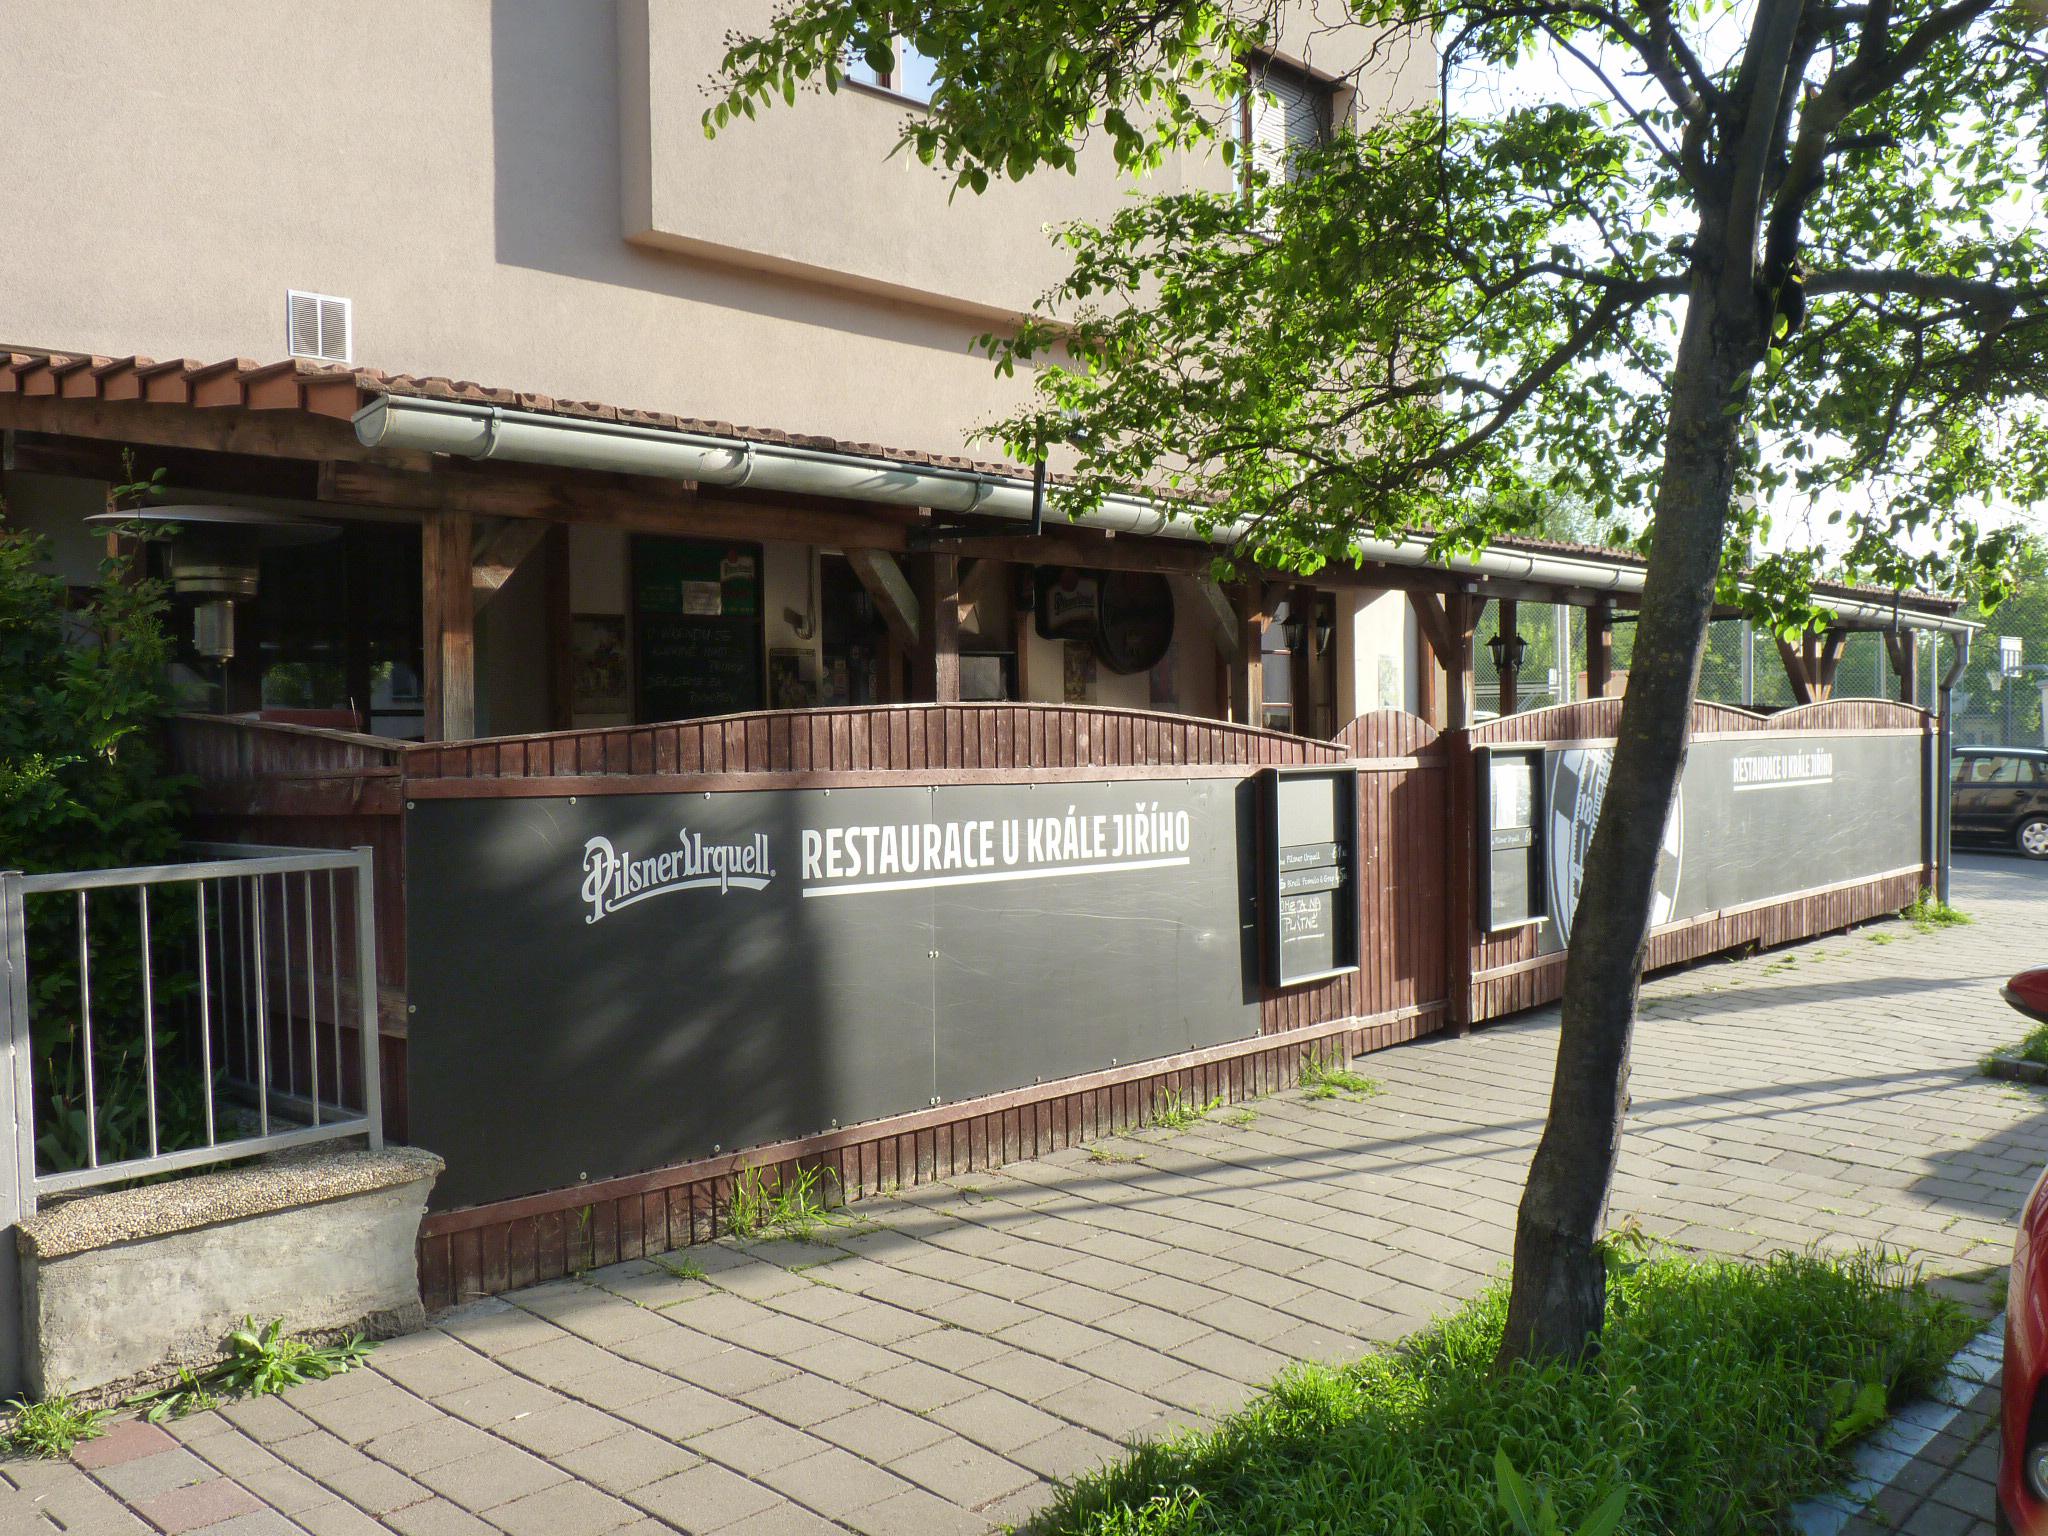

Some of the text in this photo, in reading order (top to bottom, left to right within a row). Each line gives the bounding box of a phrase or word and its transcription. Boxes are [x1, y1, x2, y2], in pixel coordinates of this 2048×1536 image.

[1733, 756, 1781, 782] RESTAURACE
[1782, 754, 1788, 779] U
[1788, 748, 1810, 778] KRÁLE
[581, 826, 770, 925] Pilsner Urquell
[802, 801, 1190, 880] RESTAURACE U KRÁLE JIŘÍHO
